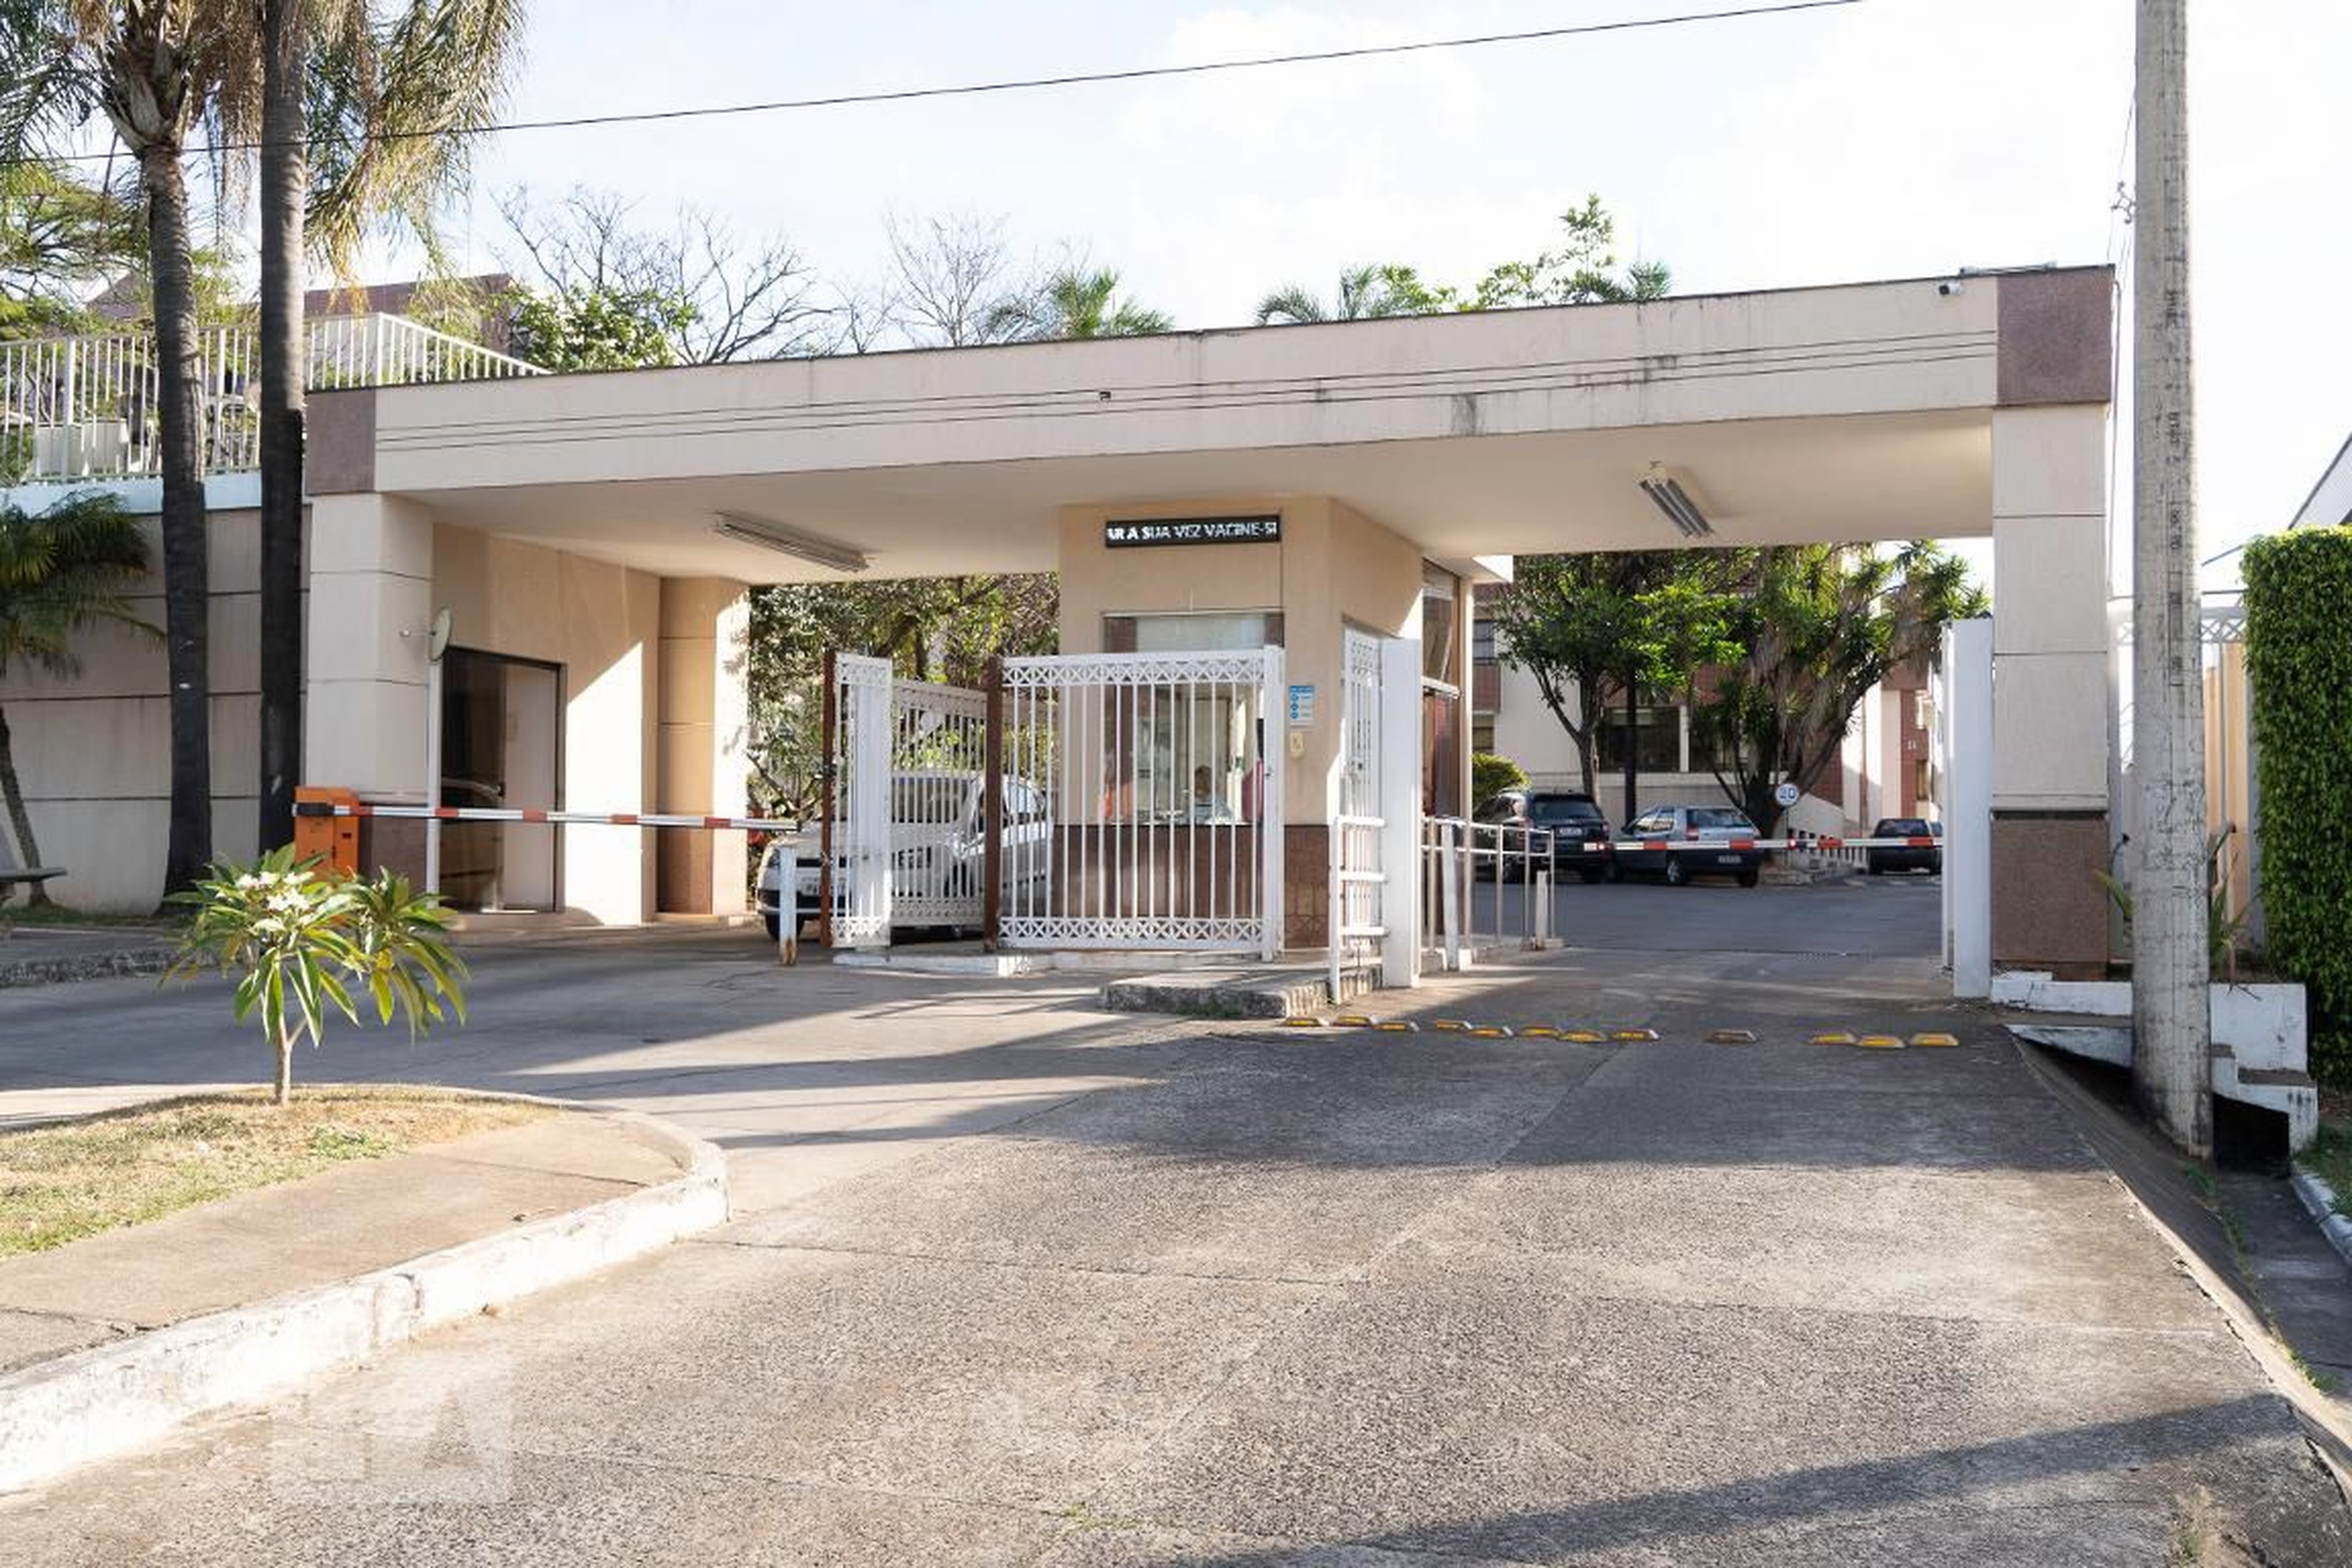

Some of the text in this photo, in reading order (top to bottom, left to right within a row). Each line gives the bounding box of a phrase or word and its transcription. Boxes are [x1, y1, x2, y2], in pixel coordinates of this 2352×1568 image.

[1127, 527, 1139, 540] A
[1142, 526, 1171, 539] SUA
[1174, 525, 1201, 538] VEZ
[1779, 787, 1796, 799] 20
